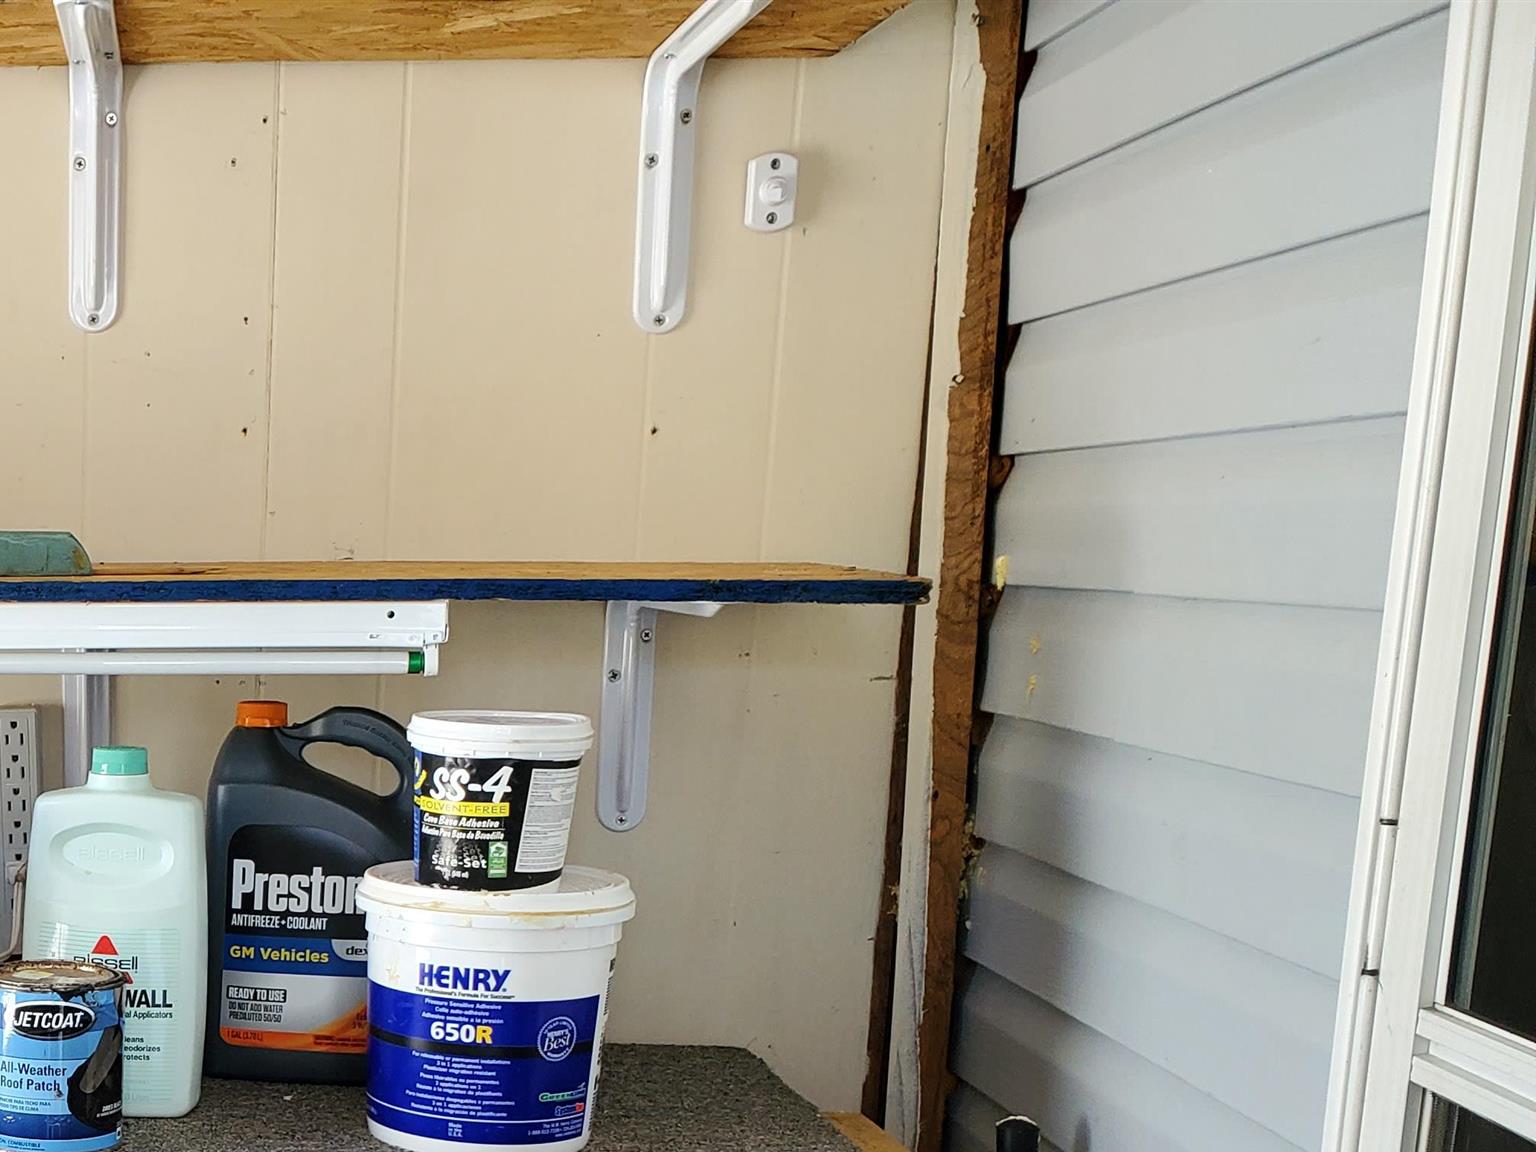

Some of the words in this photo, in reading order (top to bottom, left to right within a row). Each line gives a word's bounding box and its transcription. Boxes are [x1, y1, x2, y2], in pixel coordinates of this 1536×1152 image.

[429, 766, 514, 804] SS-4
[421, 798, 508, 814] SOLVENT-FREE
[432, 854, 488, 869] Safe-Set
[231, 858, 367, 915] Preston
[229, 946, 255, 960] GM
[260, 947, 330, 963] Vehicles
[418, 963, 512, 993] HENRY
[228, 986, 255, 1000] READY
[255, 990, 267, 1001] TO
[268, 990, 285, 1002] USE
[458, 991, 480, 999] Formula
[228, 1001, 237, 1010] DO
[237, 1002, 249, 1011] NOT
[249, 1003, 262, 1012] ADD
[263, 1004, 284, 1013] WATER
[475, 1002, 503, 1011] Adhesive
[14, 1010, 84, 1029] JETCOAT
[133, 1010, 173, 1020] Applicators
[228, 1010, 263, 1022] PREDILUTED
[263, 1013, 283, 1023] 50/50
[124, 1035, 144, 1043] leans
[430, 1020, 493, 1045] 650R
[124, 1044, 161, 1052] eodorizes
[544, 1031, 572, 1053] Best
[124, 1053, 150, 1061] rotects
[0, 1060, 68, 1077] All-Weather
[0, 1075, 24, 1090] Roof
[26, 1078, 62, 1093] Patch
